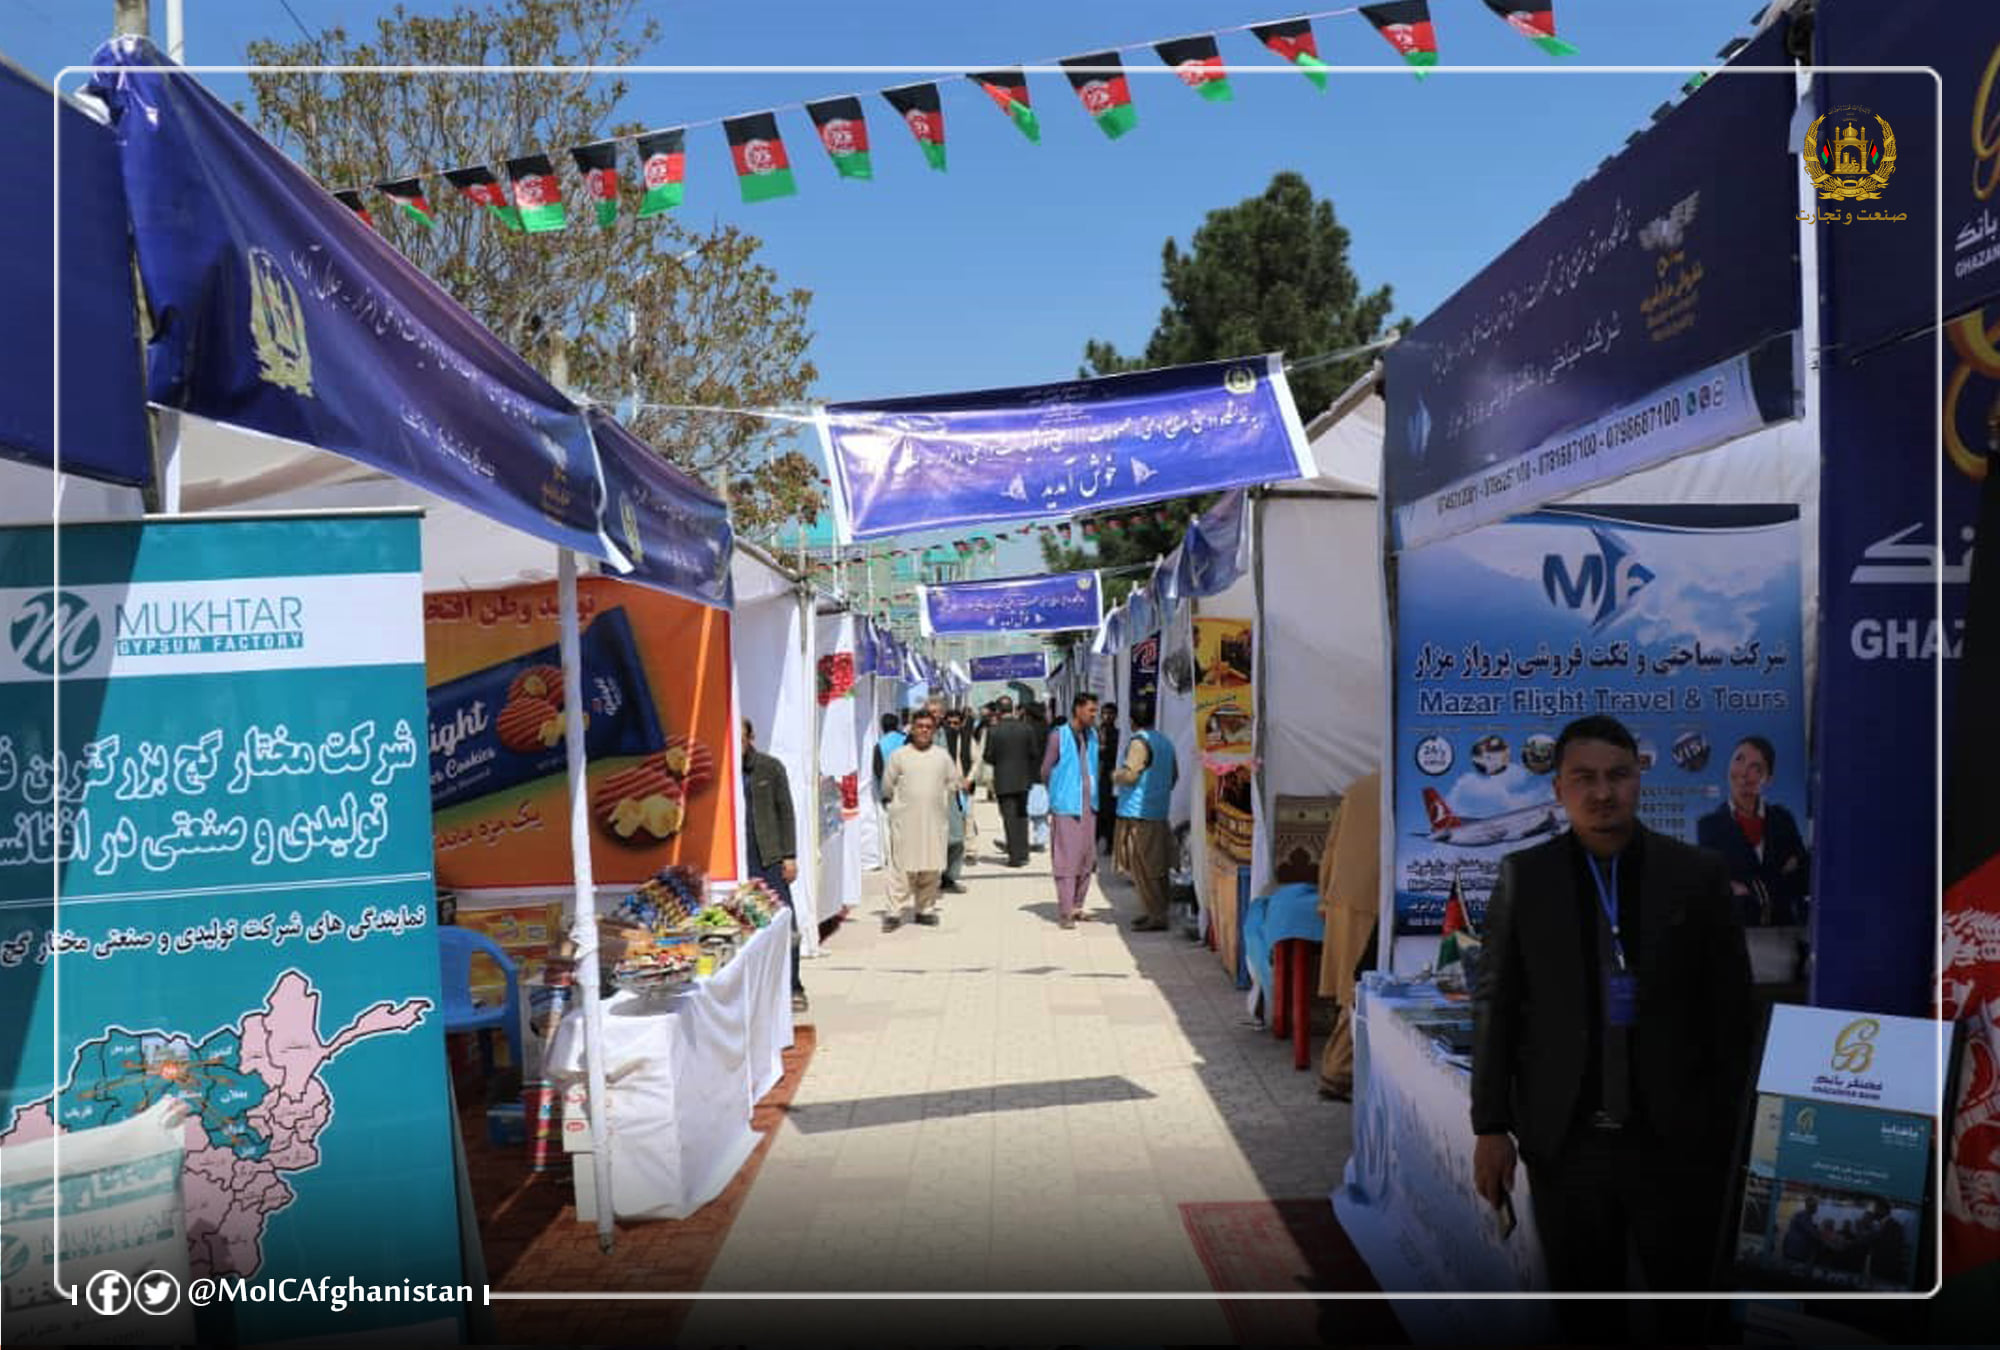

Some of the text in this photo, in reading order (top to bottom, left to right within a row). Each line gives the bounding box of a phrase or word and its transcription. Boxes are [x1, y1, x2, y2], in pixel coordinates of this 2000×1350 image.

[1041, 453, 1117, 510] خوش آمدید
[114, 596, 304, 637] MUKHTAR
[119, 632, 302, 655] GYPSUM FACTORY
[1415, 641, 1455, 679] مزار
[1516, 641, 1584, 678] فروشی
[1418, 686, 1787, 717] Mazar Flight Travel & Tours
[430, 700, 488, 757] ight
[173, 728, 224, 795] گچ
[226, 724, 315, 794] مختار
[319, 719, 417, 785] شرکت
[0, 792, 388, 876] تولیدی و صنعتی در افغانس
[174, 918, 239, 952] تولیدی
[241, 911, 303, 947] شرکت
[306, 910, 343, 941] های
[349, 904, 426, 940] نمایندگی
[94, 928, 154, 960] صنعتی
[156, 932, 171, 956] و
